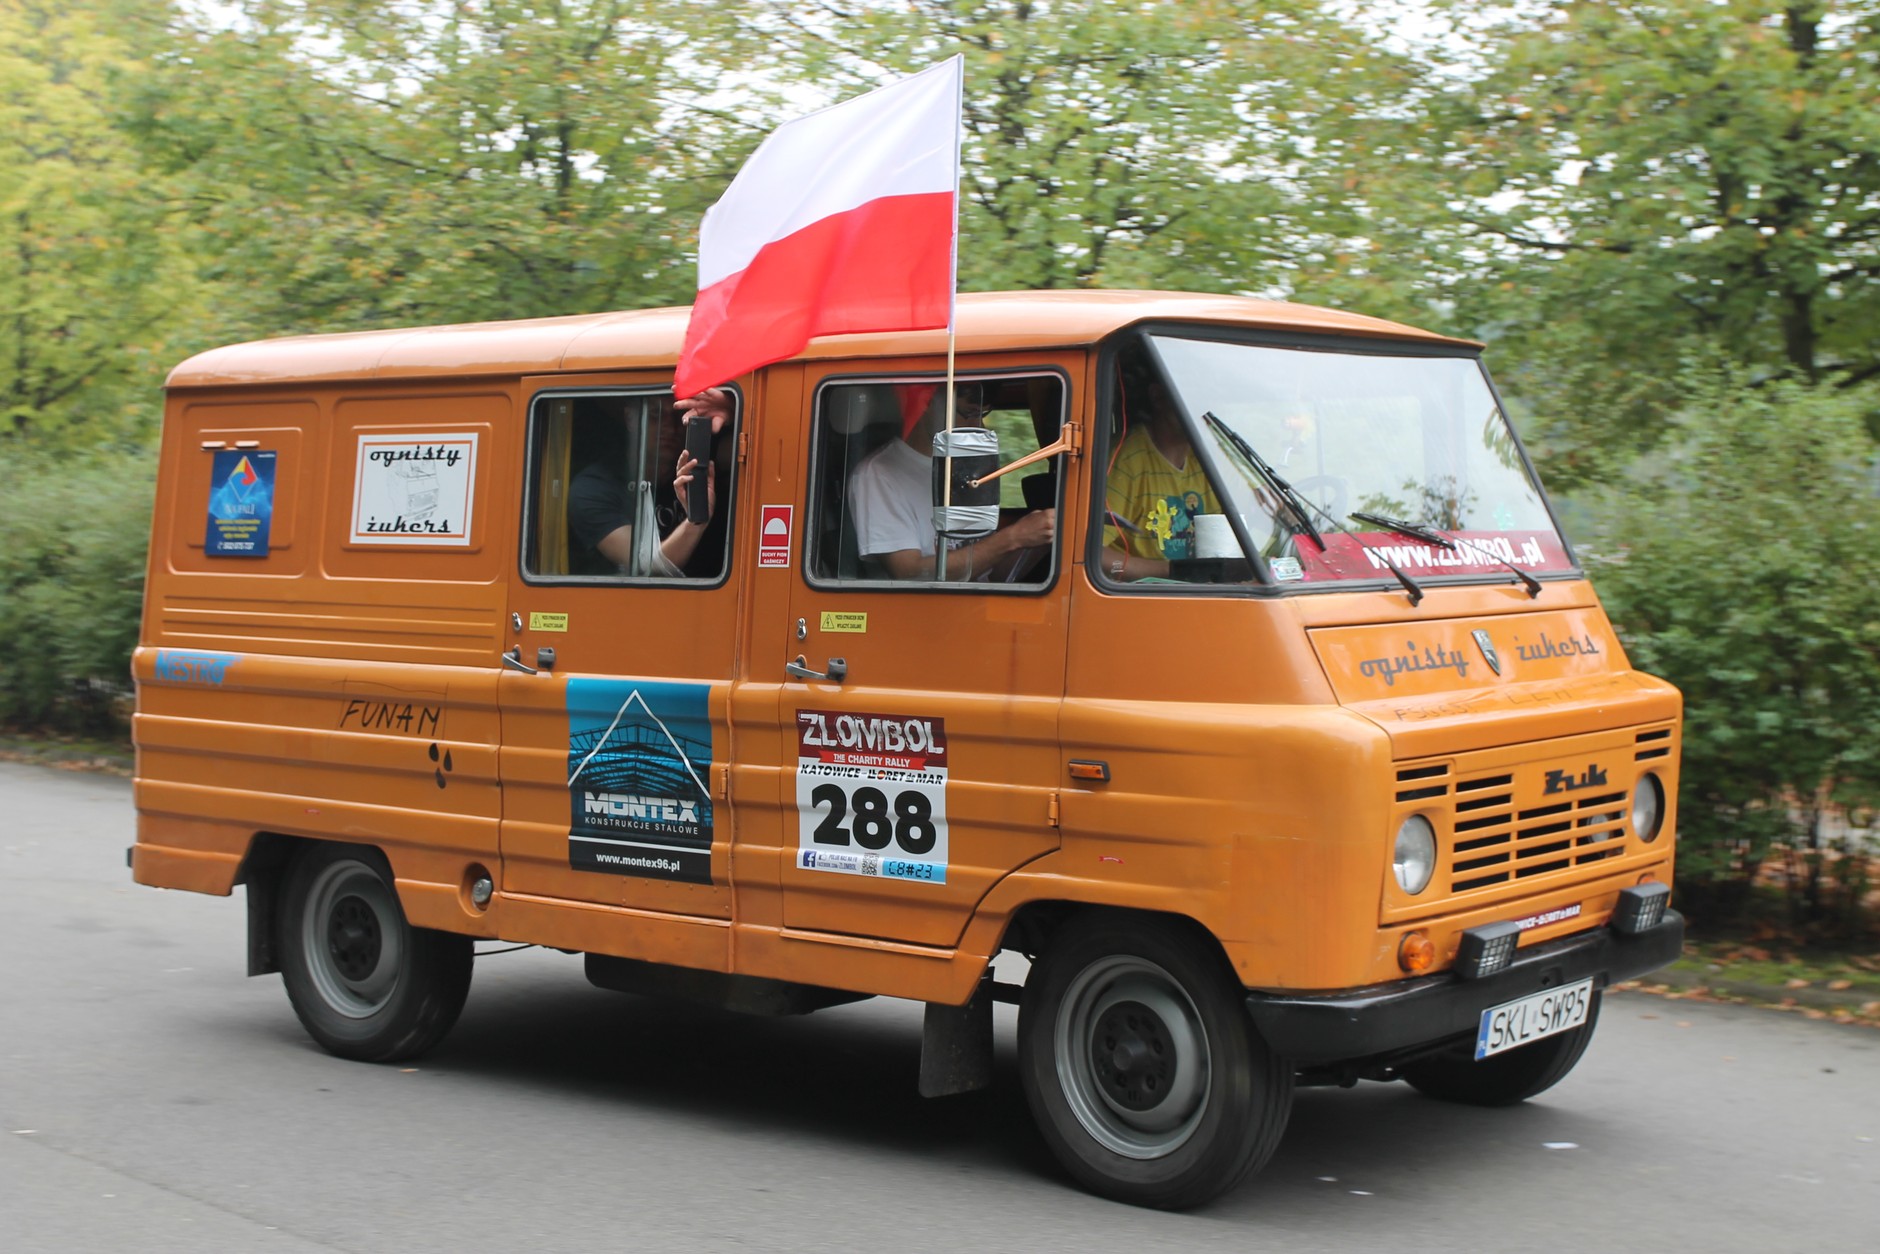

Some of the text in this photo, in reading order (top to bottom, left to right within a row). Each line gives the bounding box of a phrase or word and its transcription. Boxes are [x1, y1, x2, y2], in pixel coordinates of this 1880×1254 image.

[370, 444, 462, 467] ognisty
[1360, 640, 1469, 686] ognisty
[799, 713, 944, 754] ZLOMBOL
[833, 753, 910, 767] THE CHARITY RALLY
[800, 764, 860, 778] KATOWICE
[916, 774, 943, 785] MAR
[585, 791, 697, 823] MONTEX
[812, 784, 936, 854] 288
[585, 817, 698, 834] KONSTRUKCJE STALOWE
[596, 853, 680, 872] www.montex96.pl
[1491, 986, 1587, 1049] SKL SW95
